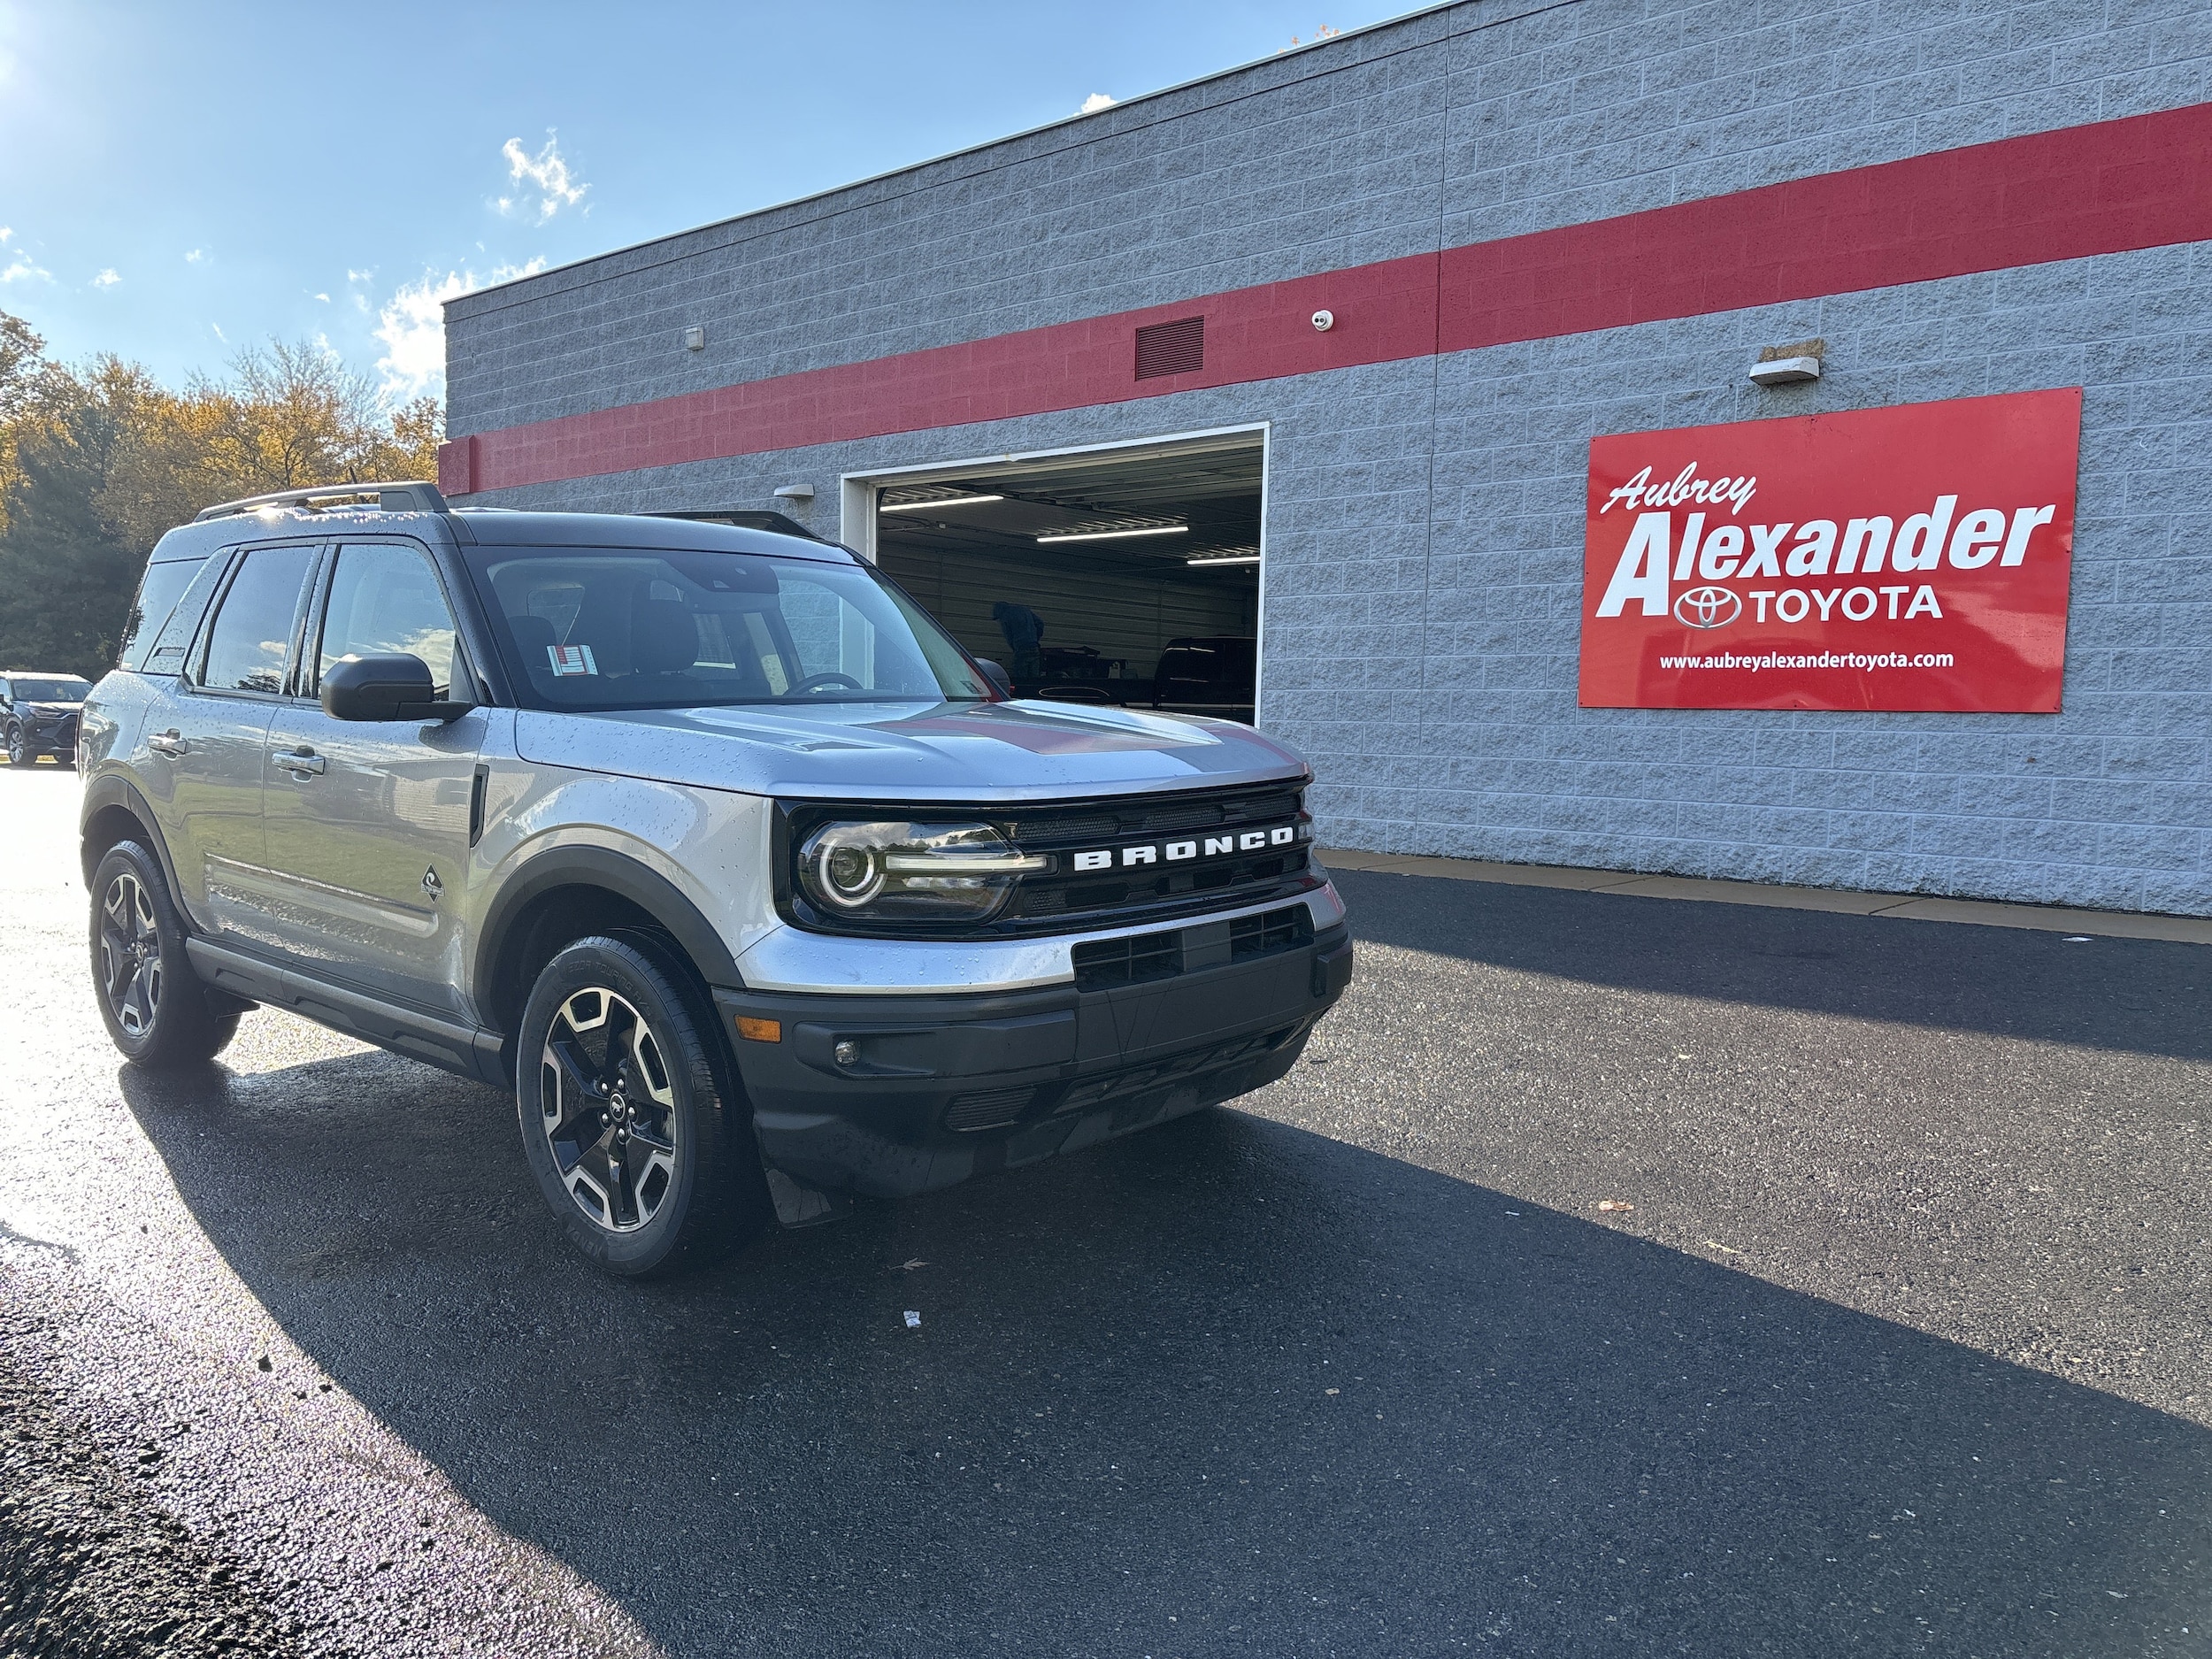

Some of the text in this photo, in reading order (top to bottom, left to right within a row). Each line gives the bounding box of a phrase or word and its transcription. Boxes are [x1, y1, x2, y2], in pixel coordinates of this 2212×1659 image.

[1600, 461, 1757, 515] Aubrey
[1595, 495, 2056, 618] Alexander
[1748, 585, 1943, 623] TOYOTA
[1660, 649, 1955, 673] www.aubreyalexandertoyota.com
[1073, 826, 1294, 872] BRONCO
